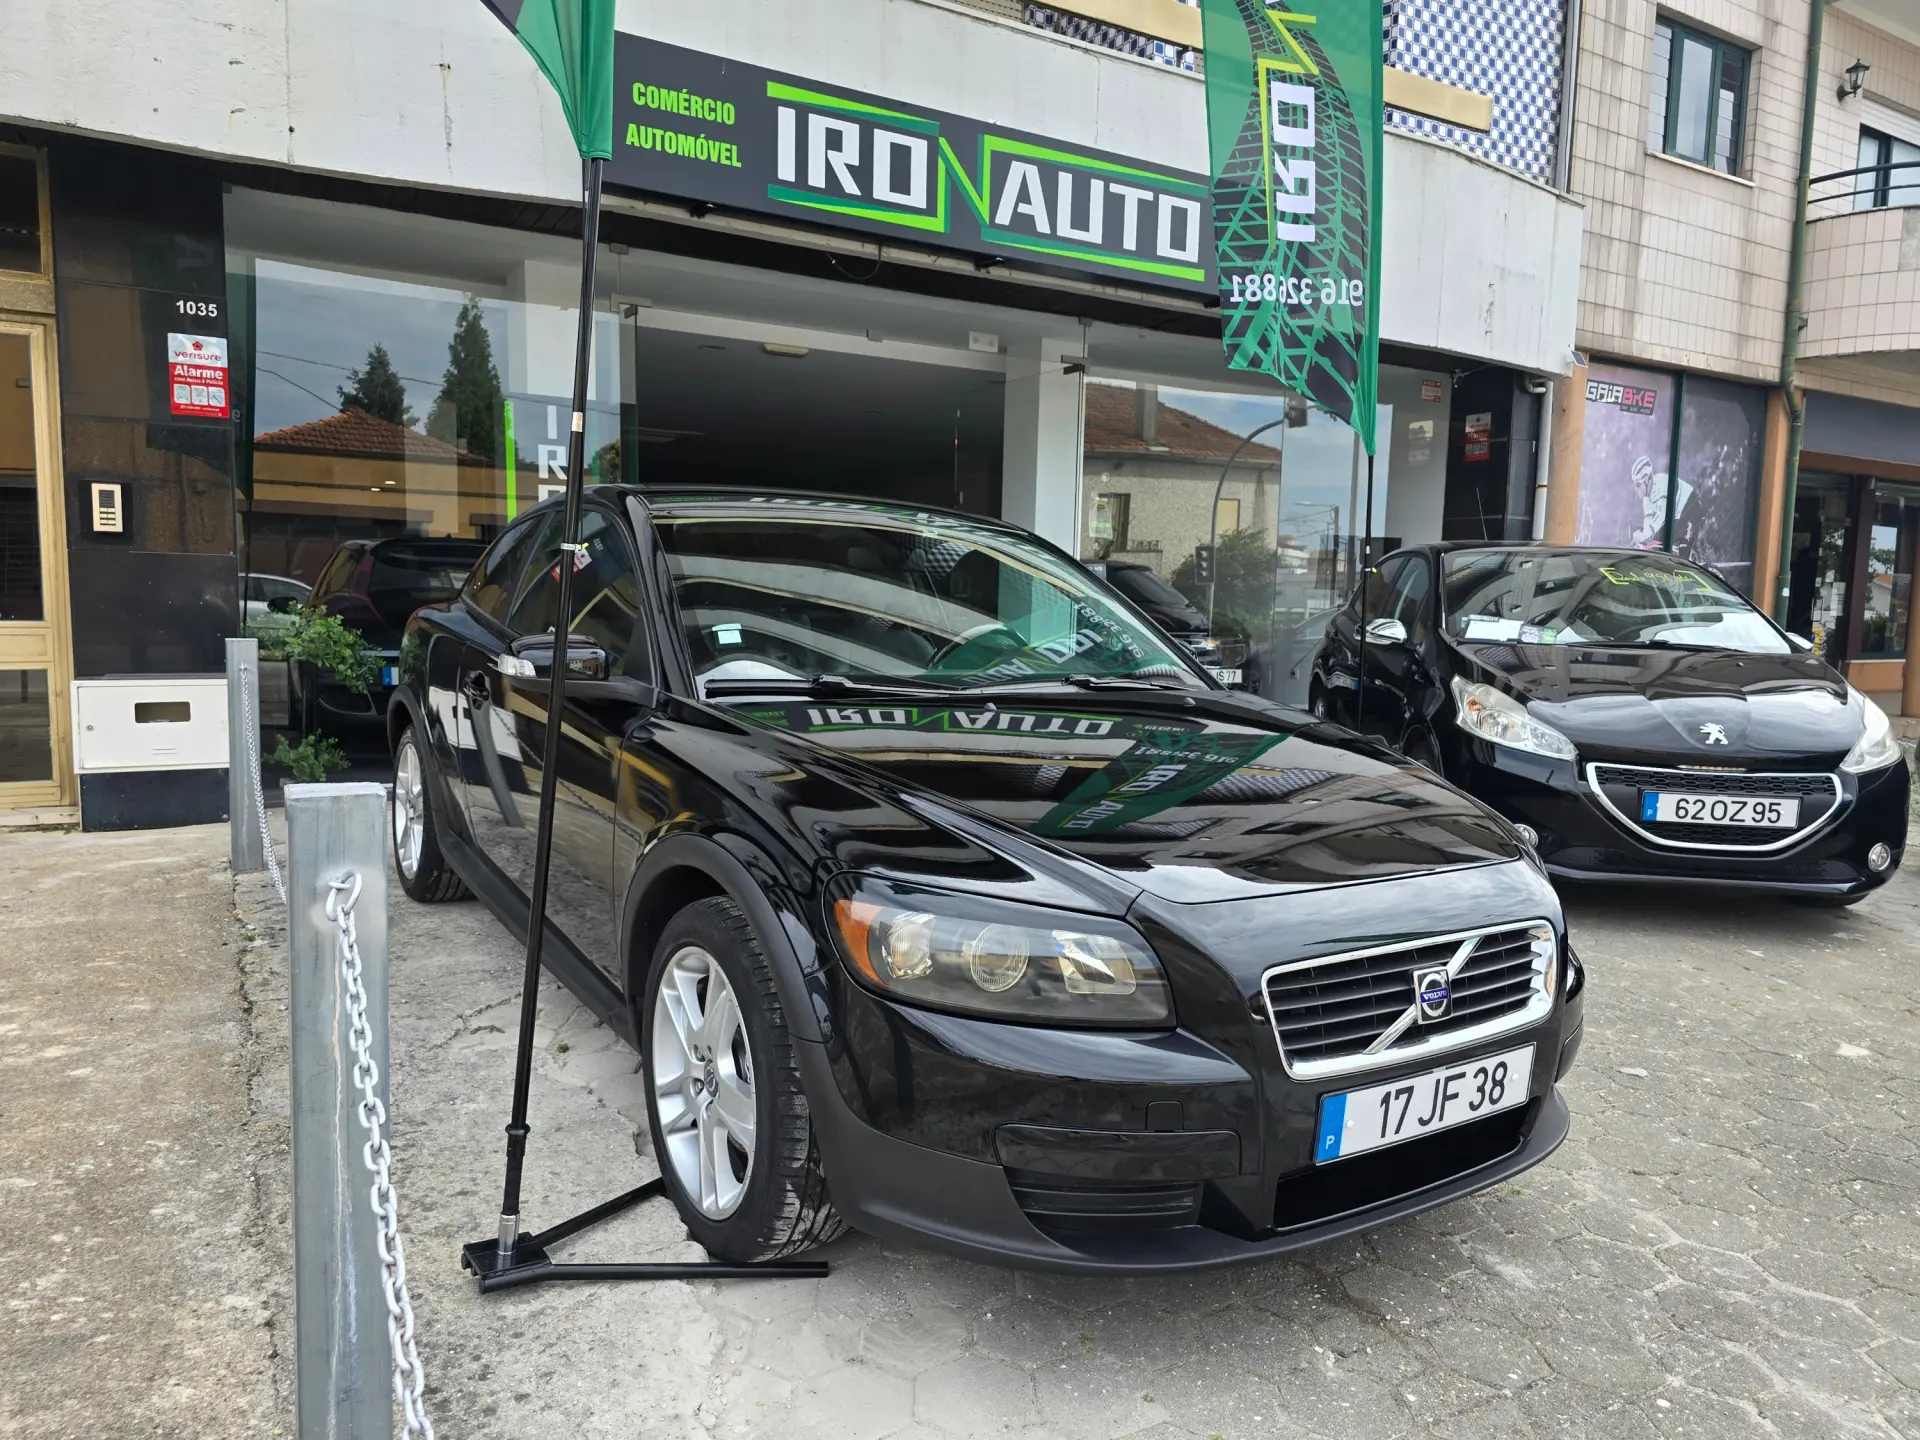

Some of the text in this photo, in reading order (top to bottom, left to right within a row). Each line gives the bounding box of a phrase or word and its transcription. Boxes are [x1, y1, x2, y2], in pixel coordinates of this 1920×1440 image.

[632, 82, 735, 126] COMÉRCIO
[625, 123, 742, 168] AUTOMÓVEL
[176, 300, 218, 317] 1035
[174, 351, 222, 361] verisure
[174, 365, 223, 380] Alarme
[1423, 990, 1448, 1000] VOLVO
[1325, 1135, 1335, 1150] P
